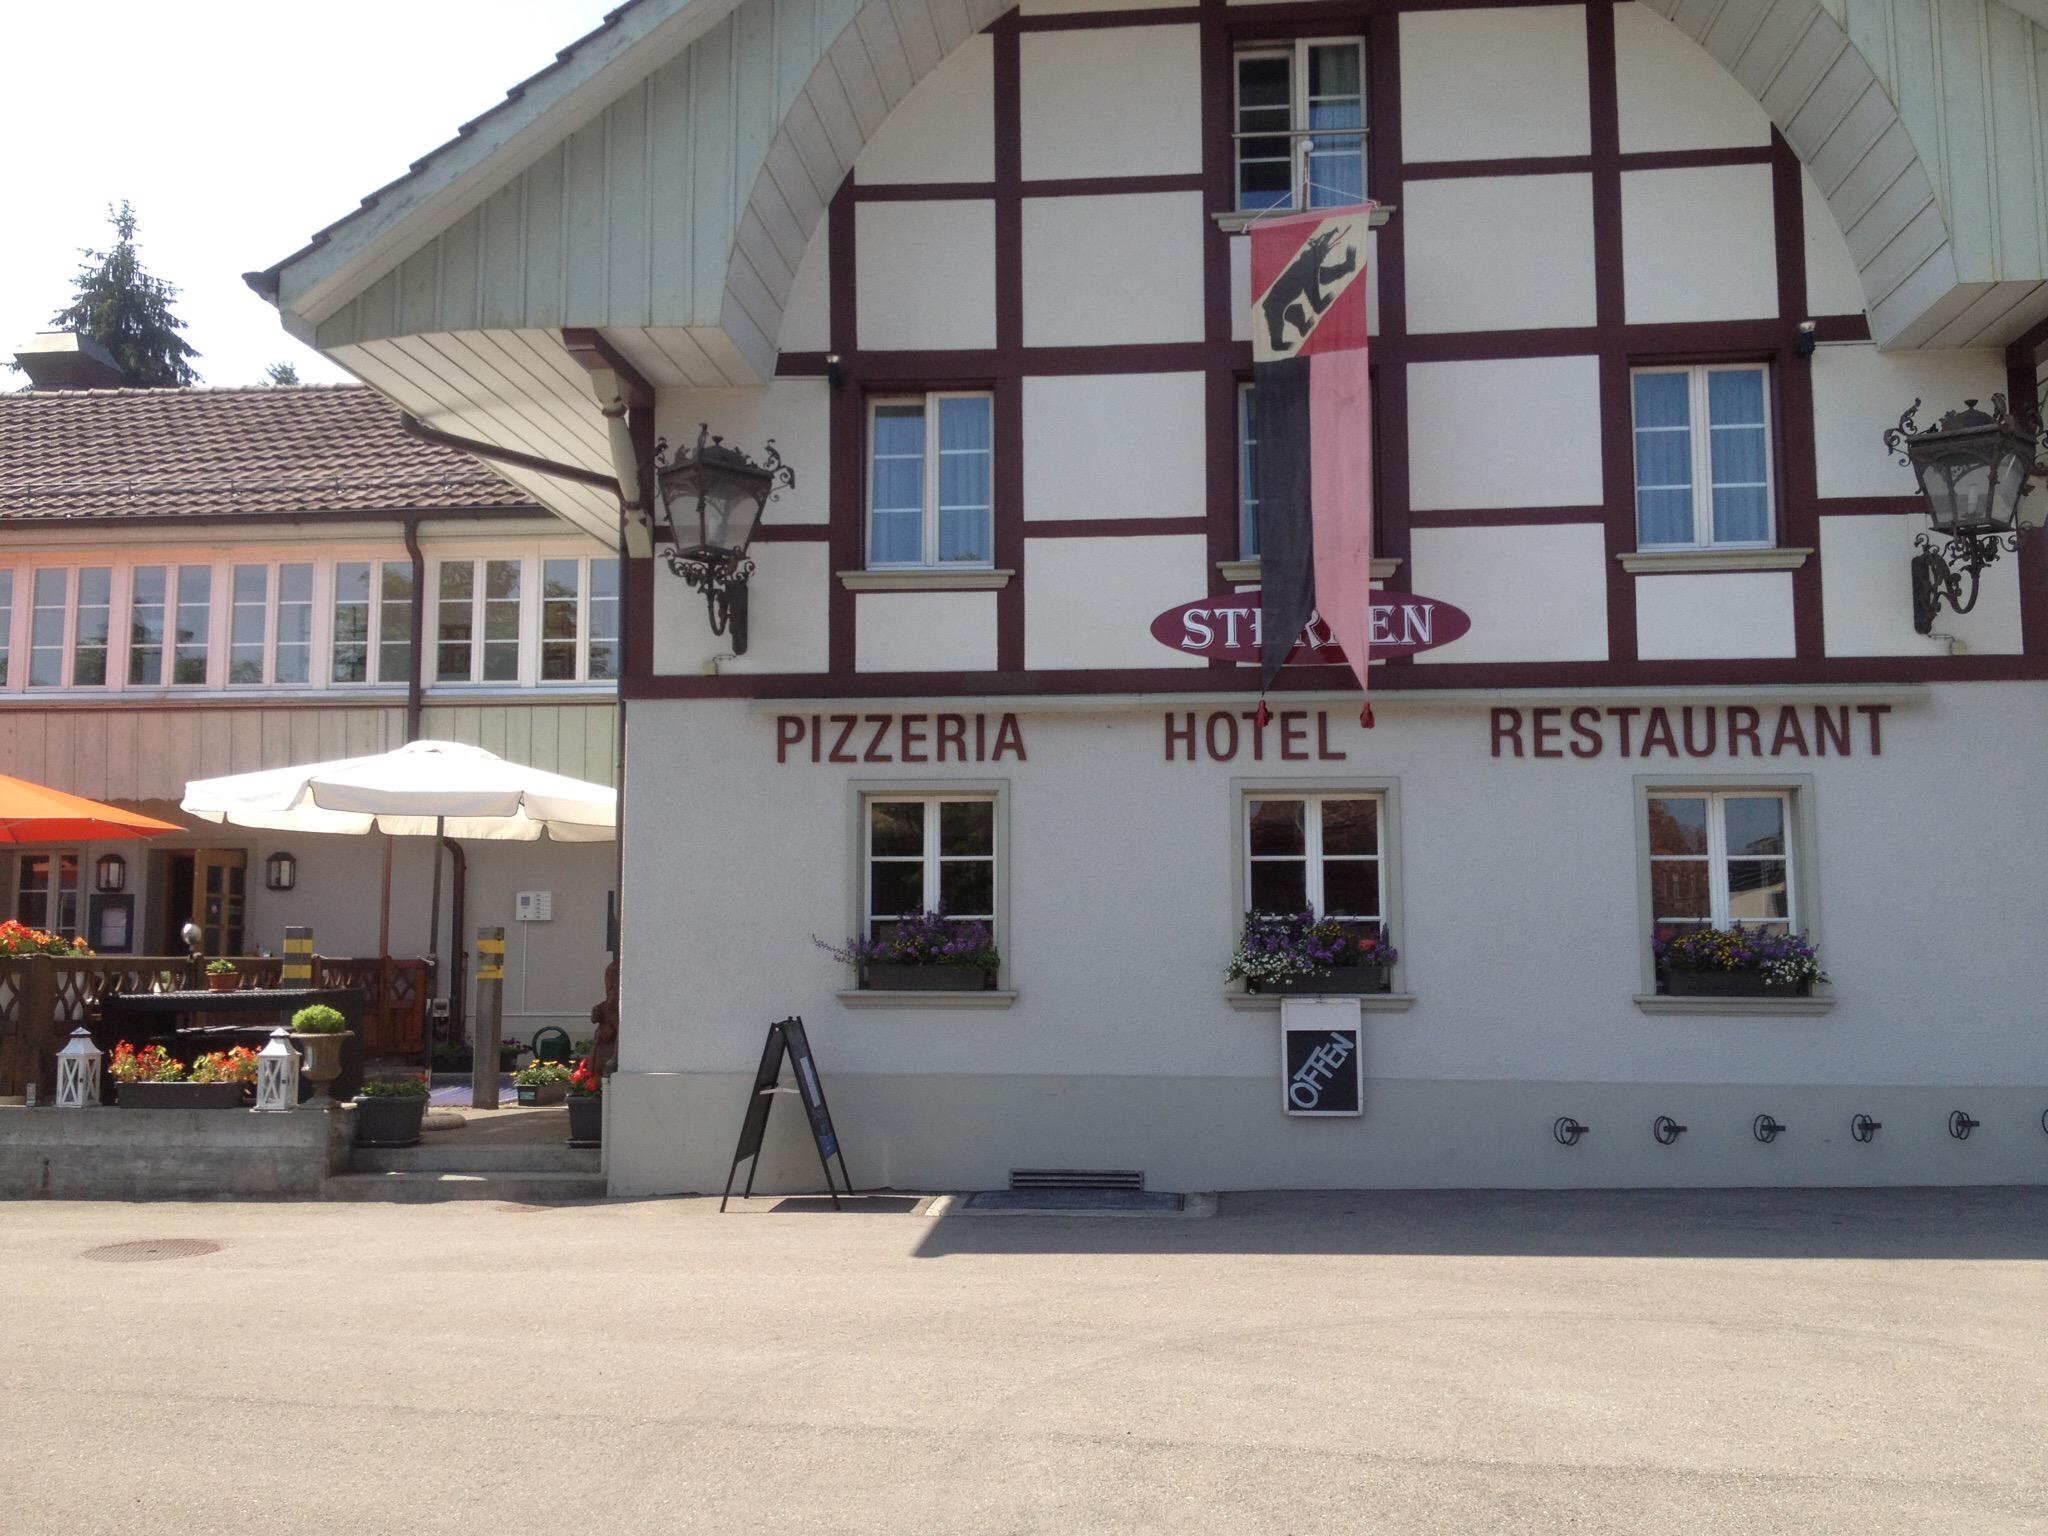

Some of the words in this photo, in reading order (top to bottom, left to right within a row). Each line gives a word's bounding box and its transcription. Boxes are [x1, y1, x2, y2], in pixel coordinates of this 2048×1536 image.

[777, 712, 1028, 763] PIZZERIA
[1165, 711, 1347, 762] HOTEL
[1490, 704, 1892, 759] RESTAURANT
[1289, 1031, 1355, 1109] OFFEN
